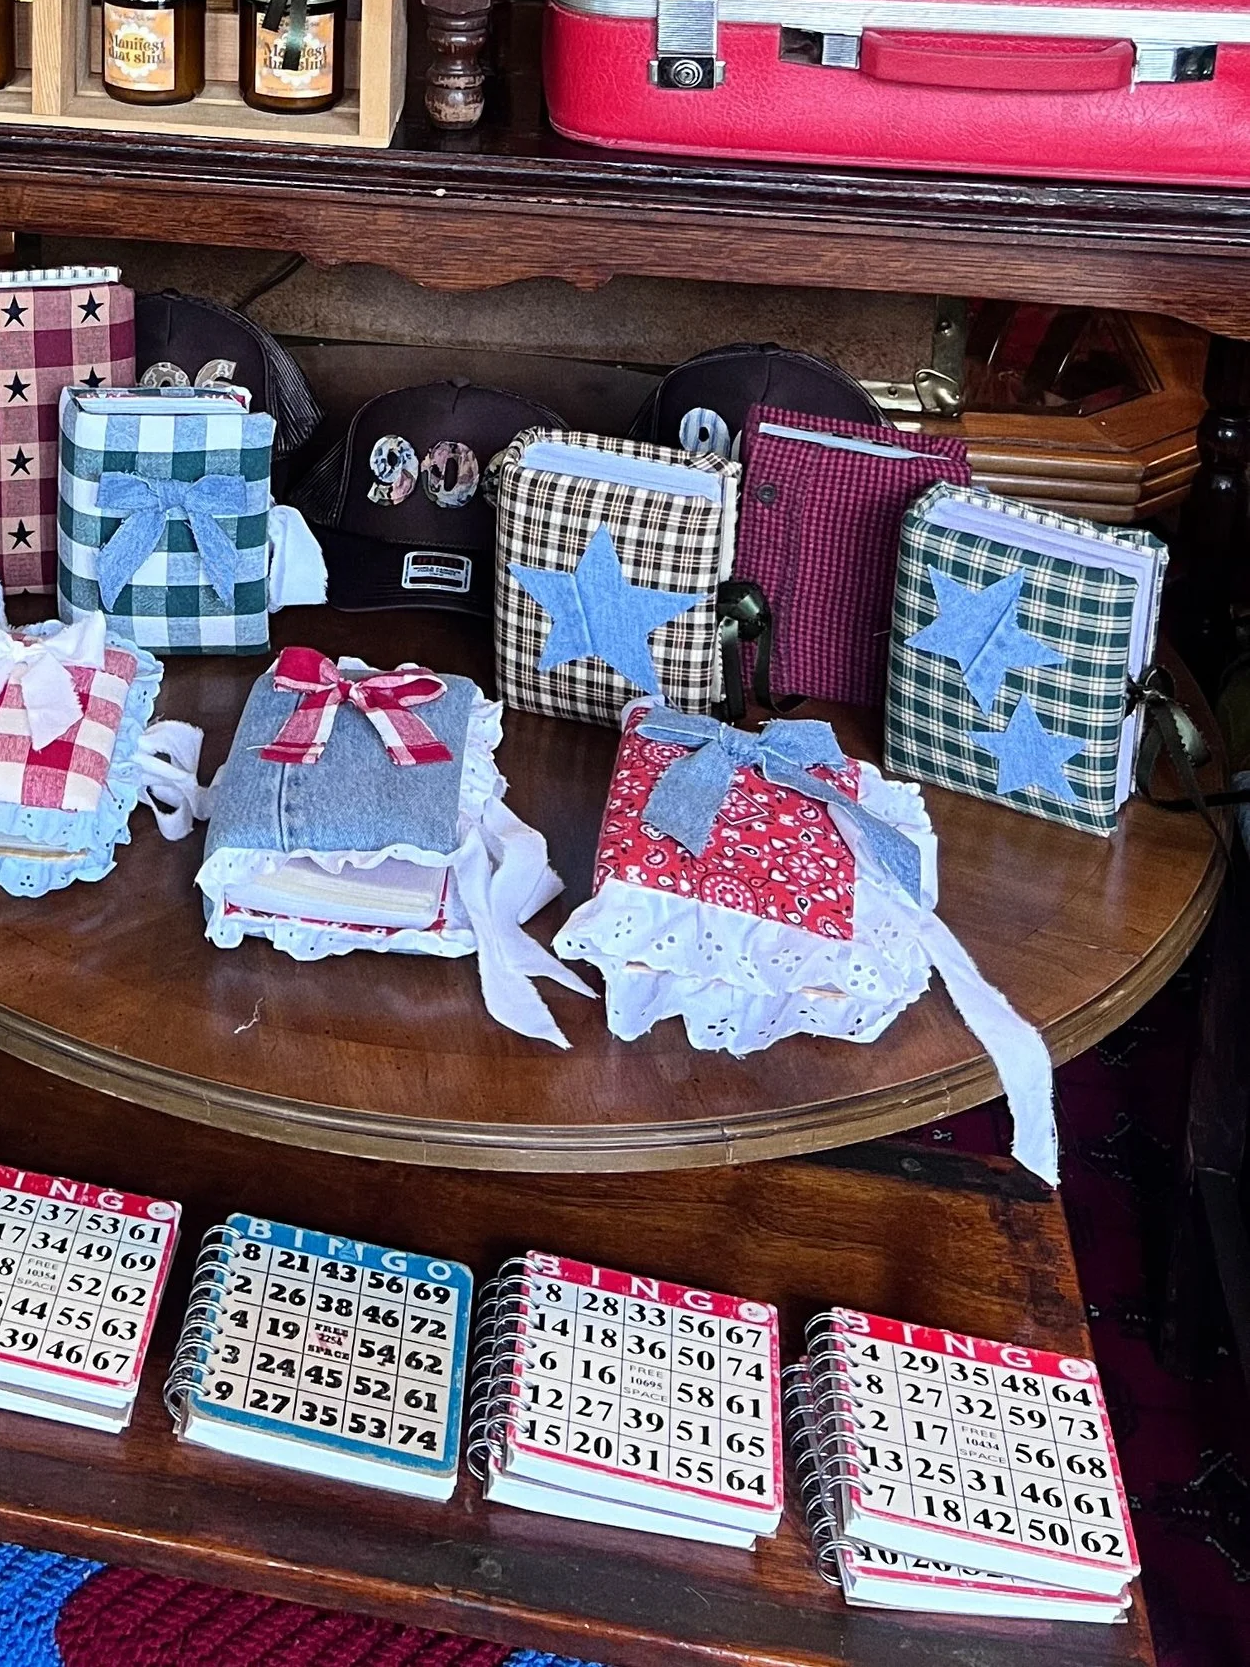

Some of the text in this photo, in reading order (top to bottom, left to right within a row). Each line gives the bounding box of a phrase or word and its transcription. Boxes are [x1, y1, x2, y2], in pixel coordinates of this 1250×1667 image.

[0, 1195, 36, 1215] 25
[41, 1204, 79, 1224] 37
[86, 1214, 120, 1234] 53
[129, 1224, 161, 1244] 61
[27, 1258, 59, 1271] FREE
[32, 1232, 68, 1254] 34
[76, 1243, 112, 1262] 49
[121, 1253, 156, 1271] 69
[242, 1243, 450, 1305] 8 21 43 56 69
[16, 1278, 57, 1292] SPACE
[67, 1274, 101, 1296] 52
[111, 1285, 146, 1306] 62
[234, 1275, 447, 1340] 2 26 38 46 72
[546, 1284, 762, 1348] 8 28 33 56 67
[11, 1298, 48, 1320] 44
[57, 1307, 93, 1330] 55
[102, 1318, 137, 1340] 63
[230, 1310, 443, 1375] 4 19 54 62
[314, 1324, 349, 1336] FREE
[533, 1313, 764, 1381] 14 18 36 50 74
[0, 1328, 38, 1351] 39
[46, 1341, 83, 1364] 46
[92, 1351, 130, 1374] 67
[221, 1344, 437, 1413] 3 24 45 52 61
[307, 1344, 350, 1360] SPACE
[629, 1365, 664, 1378] FREE
[862, 1344, 1092, 1406] 4 29 35 48 64
[215, 1381, 437, 1451] 9 27 35 53 74
[540, 1351, 761, 1419] 6 16 58 61
[623, 1387, 668, 1403] SPACE
[866, 1374, 1098, 1440] 8 27 32 59 73
[530, 1384, 764, 1457] 12 27 39 51 65
[870, 1410, 1107, 1478] 2 17 56 68
[961, 1426, 997, 1440] FREE
[526, 1420, 766, 1495] 15 20 31 55 64
[867, 1446, 1113, 1519] 13 25 31 46 61
[959, 1448, 1007, 1464] SPACE
[879, 1484, 1123, 1557] 7 18 42 50 62
